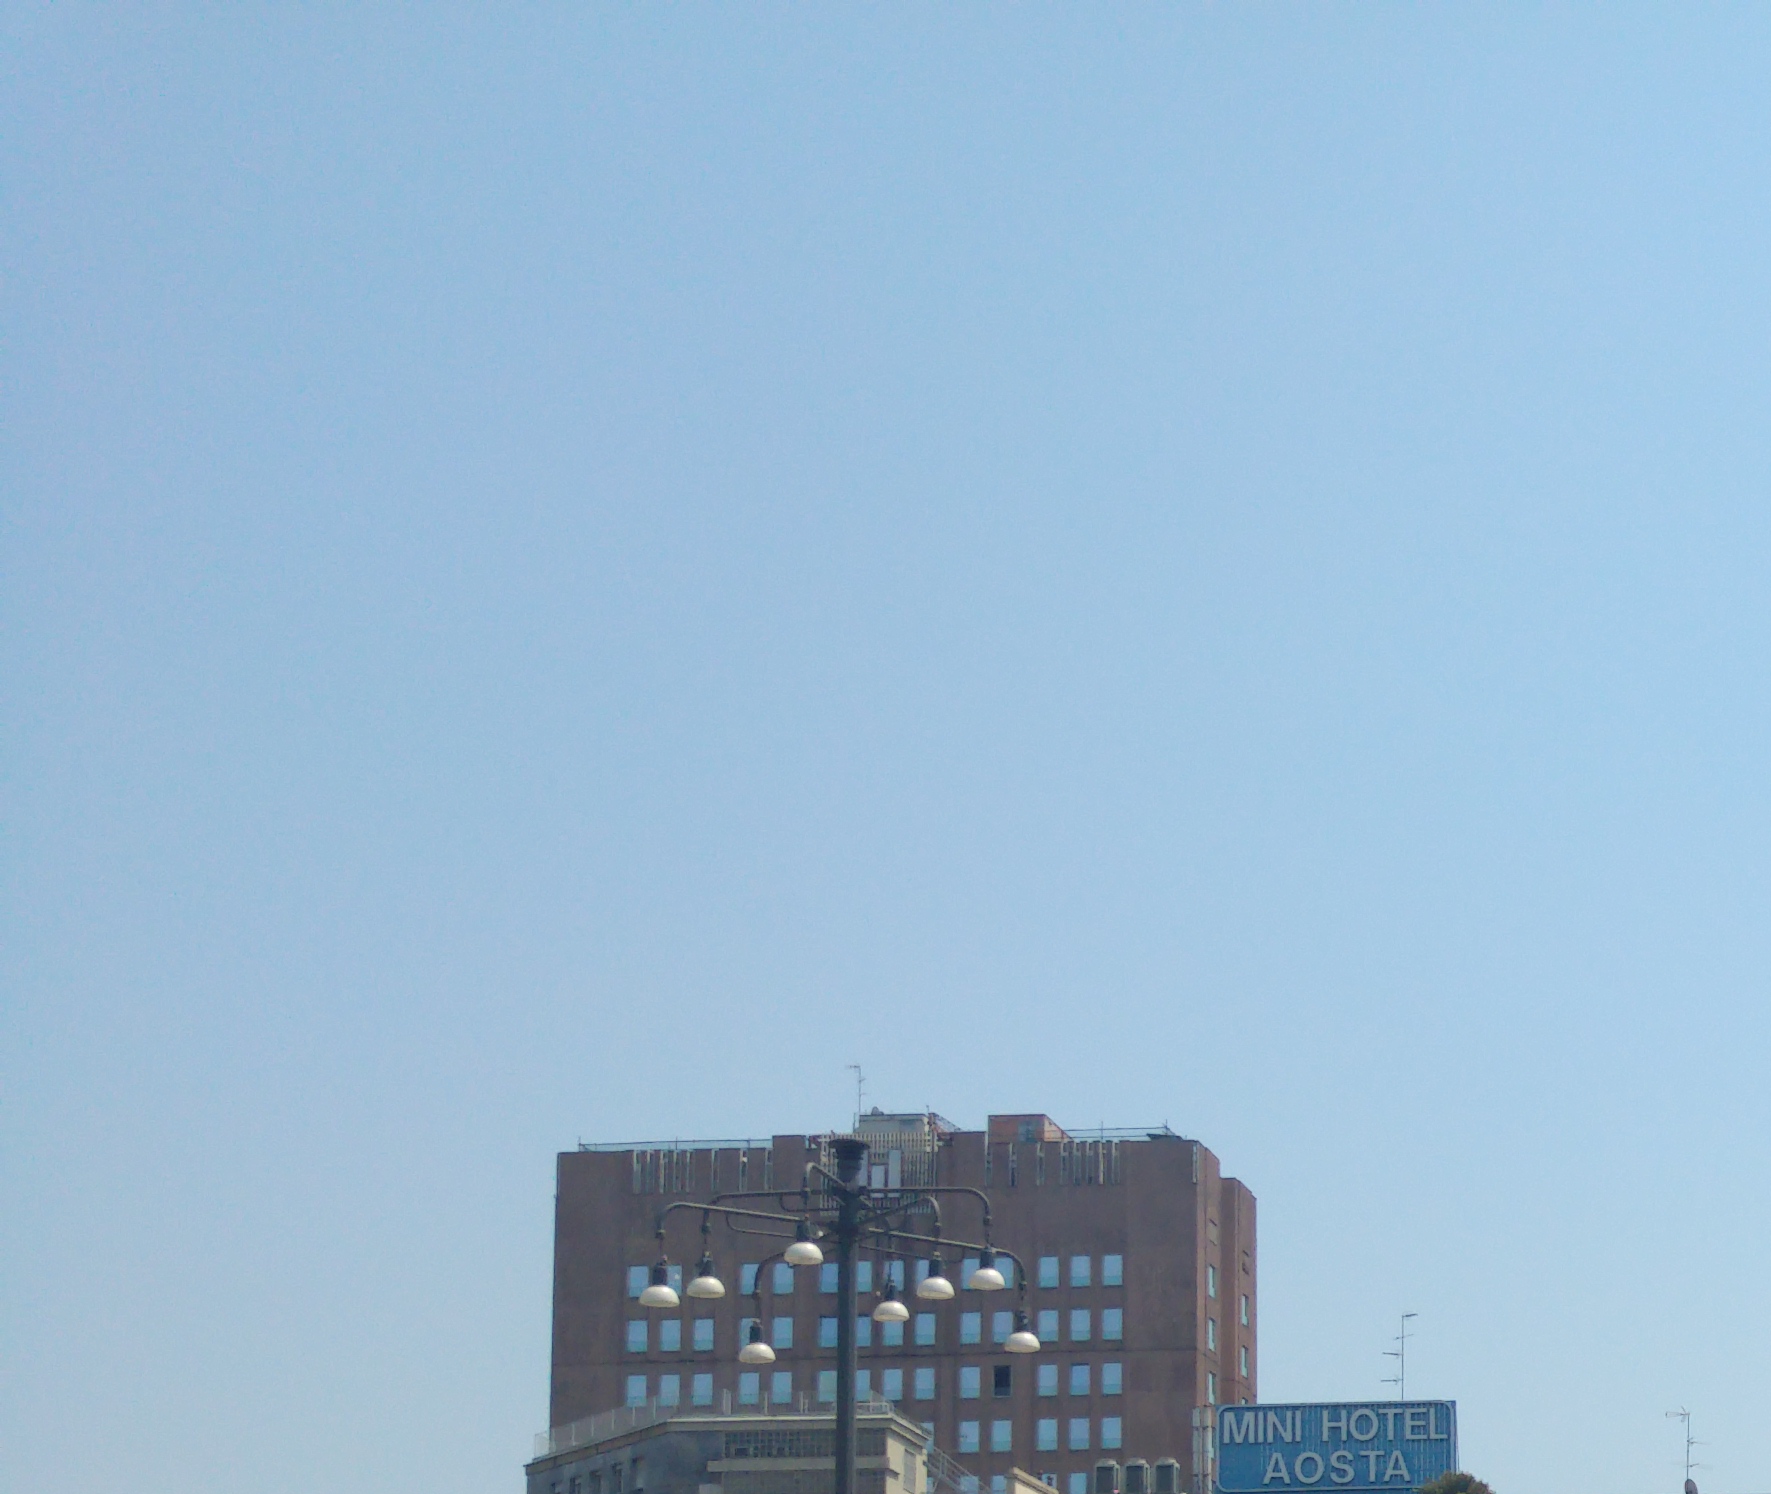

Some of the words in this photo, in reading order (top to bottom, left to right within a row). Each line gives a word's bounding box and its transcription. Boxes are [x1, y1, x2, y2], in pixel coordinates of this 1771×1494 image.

[1222, 1410, 1302, 1444] MINI
[1322, 1408, 1449, 1442] HOTEL
[1262, 1450, 1411, 1485] AOSTA
